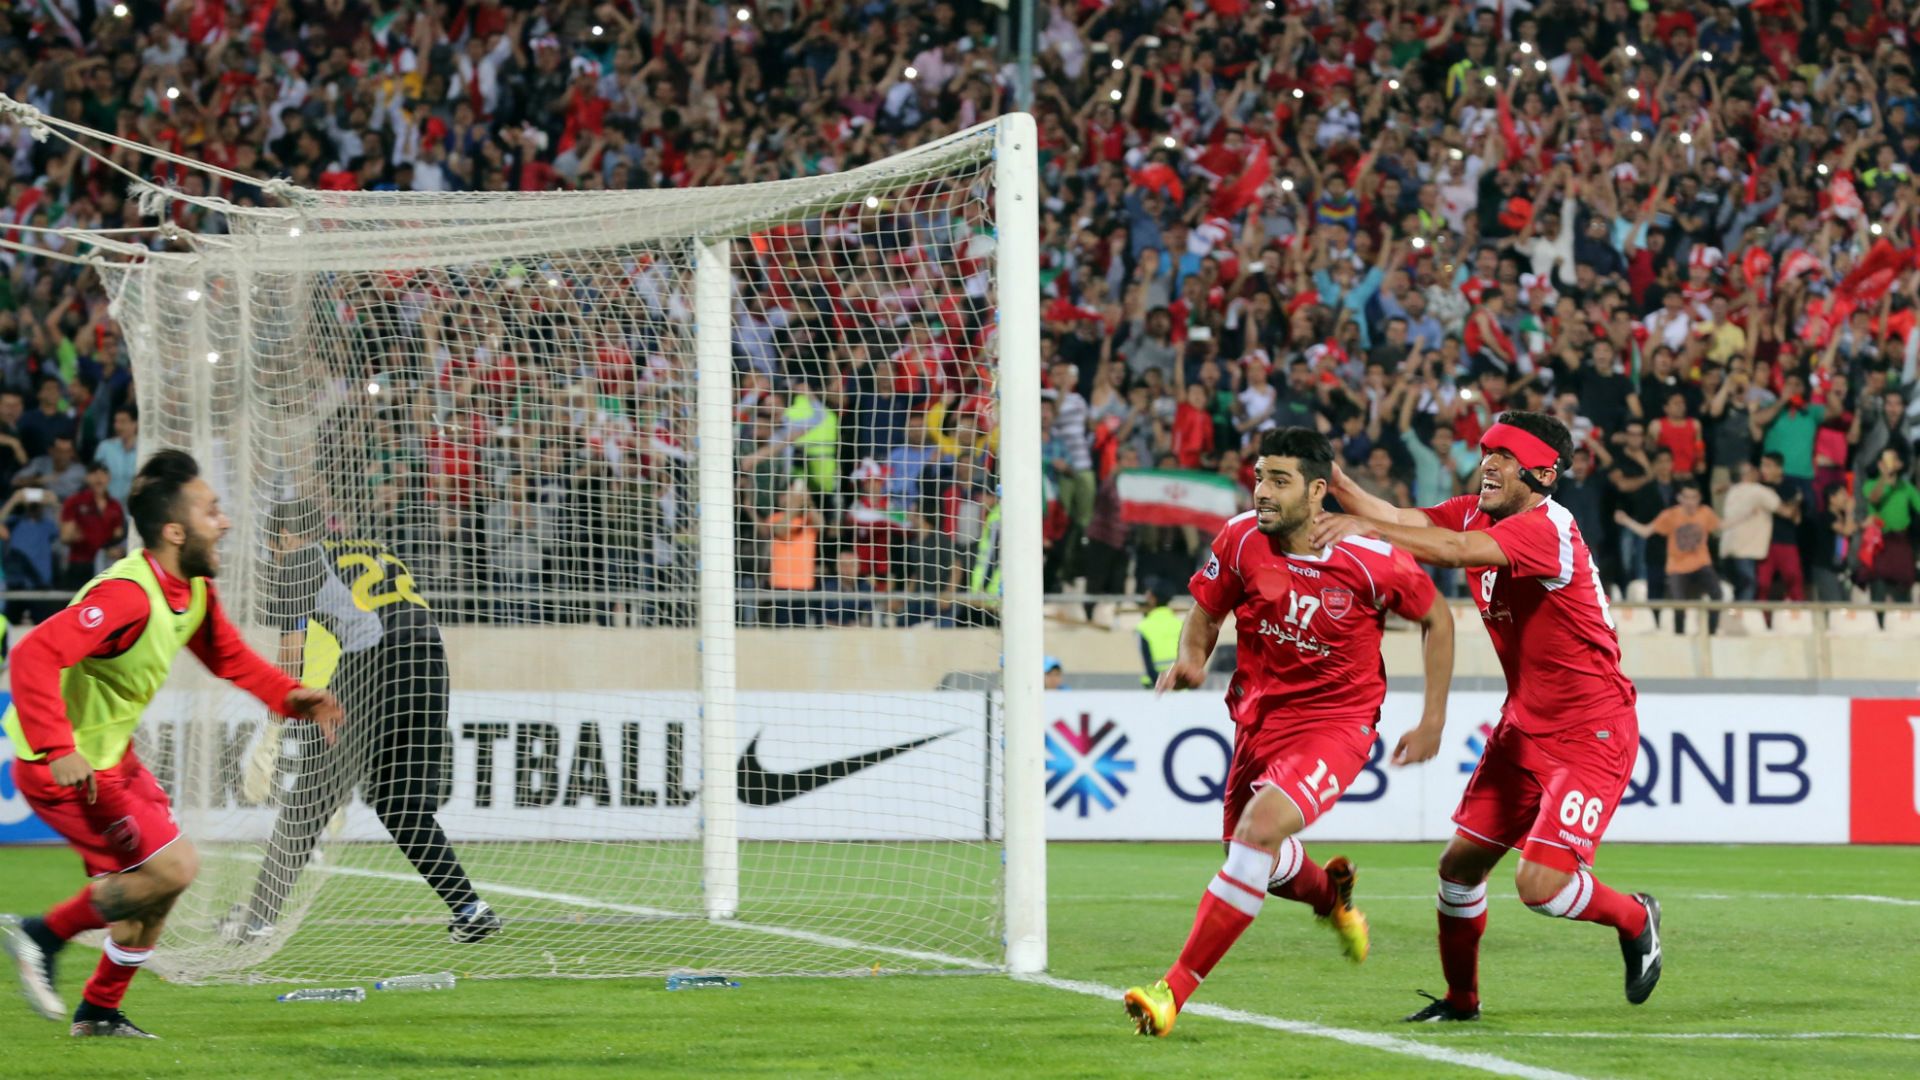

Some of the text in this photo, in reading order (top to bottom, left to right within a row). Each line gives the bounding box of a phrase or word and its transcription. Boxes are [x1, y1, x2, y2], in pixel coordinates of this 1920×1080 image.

[1284, 589, 1321, 630] 17
[357, 722, 698, 807] TBALL
[1304, 758, 1340, 804] 17
[1560, 790, 1603, 834] 66
